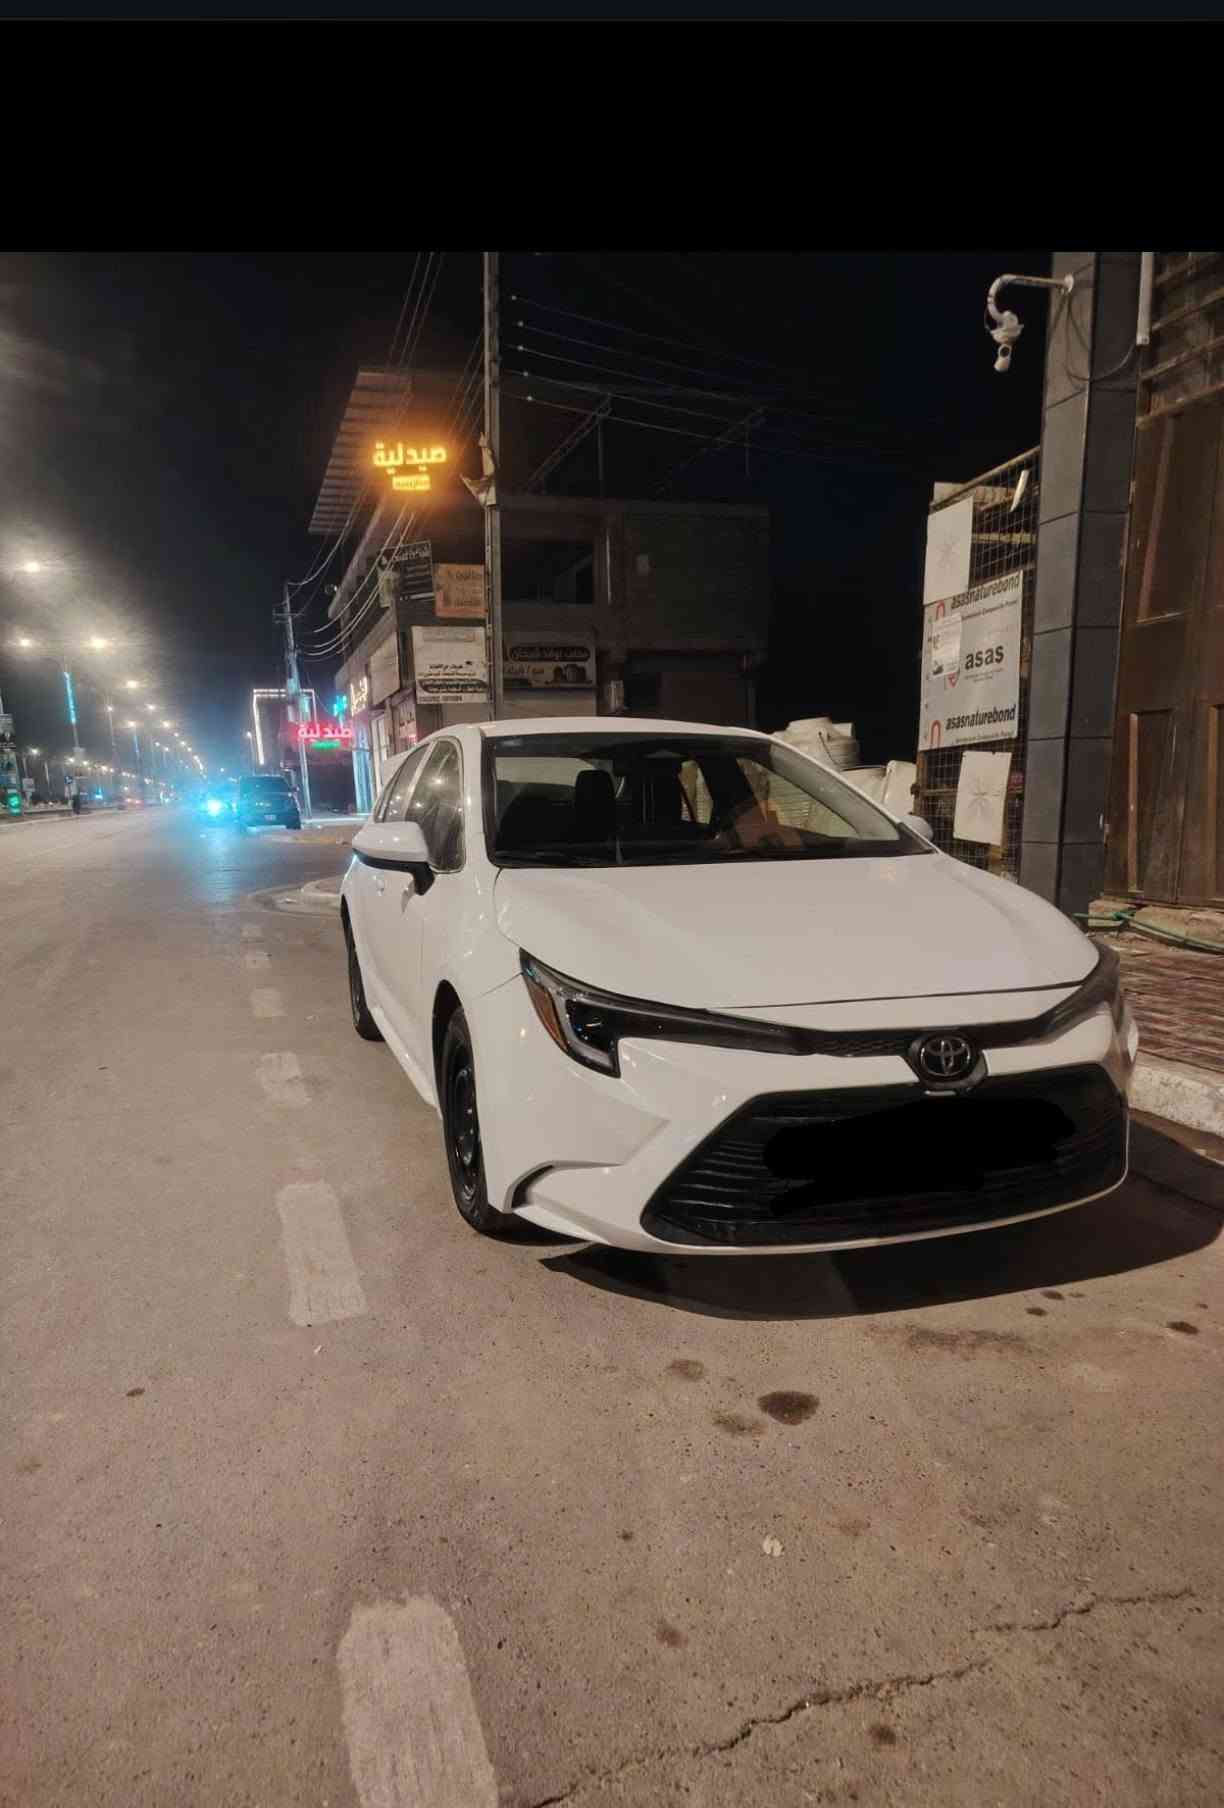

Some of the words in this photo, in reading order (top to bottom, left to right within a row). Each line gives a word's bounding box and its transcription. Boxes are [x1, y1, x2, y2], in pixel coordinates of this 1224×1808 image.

[373, 442, 447, 475] صيدلية
[964, 645, 1005, 670] asas
[945, 704, 1016, 731] asasnaturebond
[298, 723, 353, 743] صيدلية
